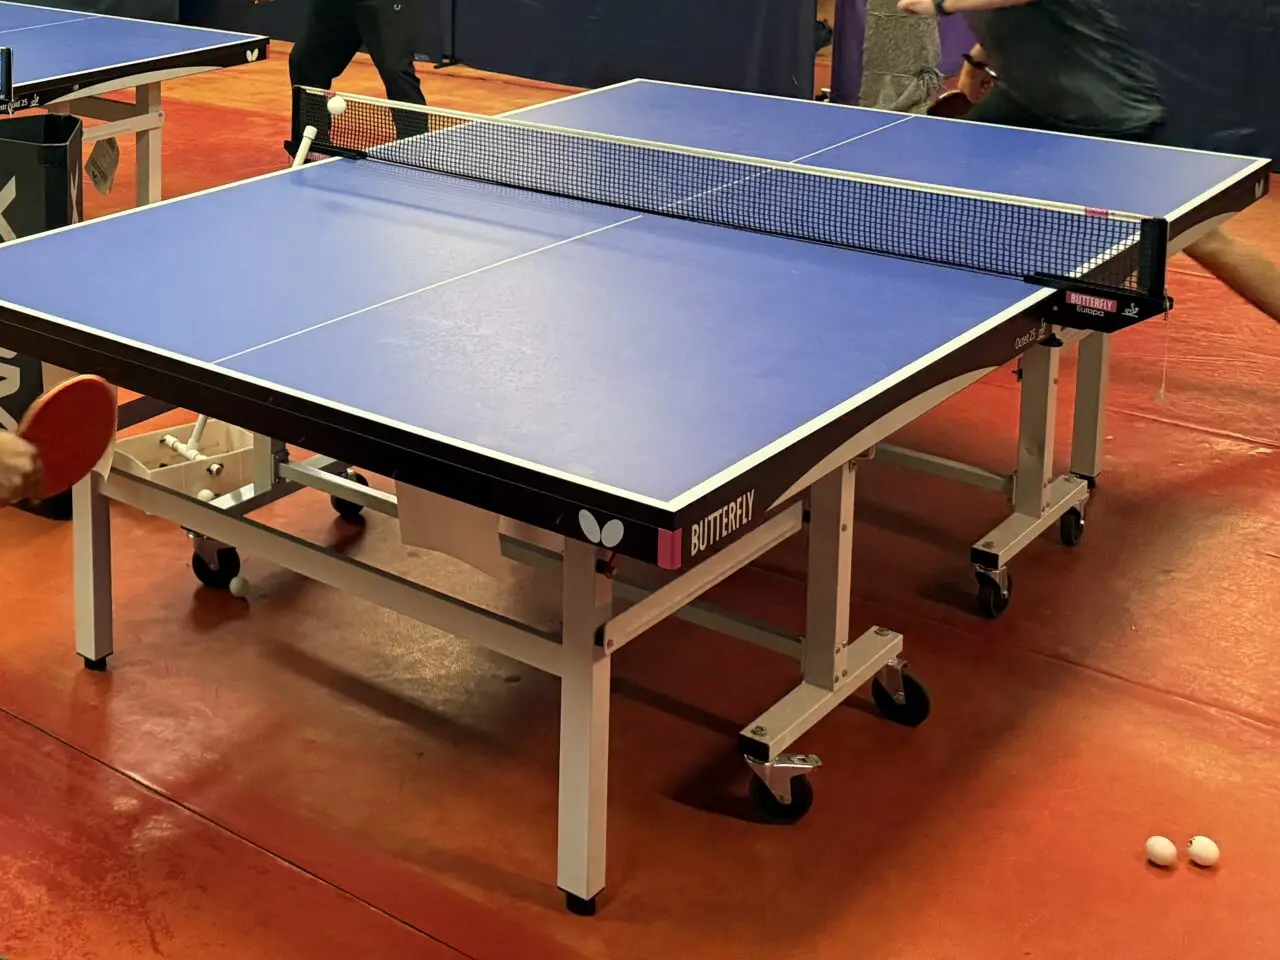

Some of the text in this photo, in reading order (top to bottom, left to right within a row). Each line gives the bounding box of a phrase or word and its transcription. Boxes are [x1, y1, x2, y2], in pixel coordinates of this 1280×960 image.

[21, 99, 29, 107] 25
[1070, 293, 1114, 312] BUTTERFLY
[1076, 305, 1105, 317] Europa
[691, 488, 755, 557] BUTTERFLY
